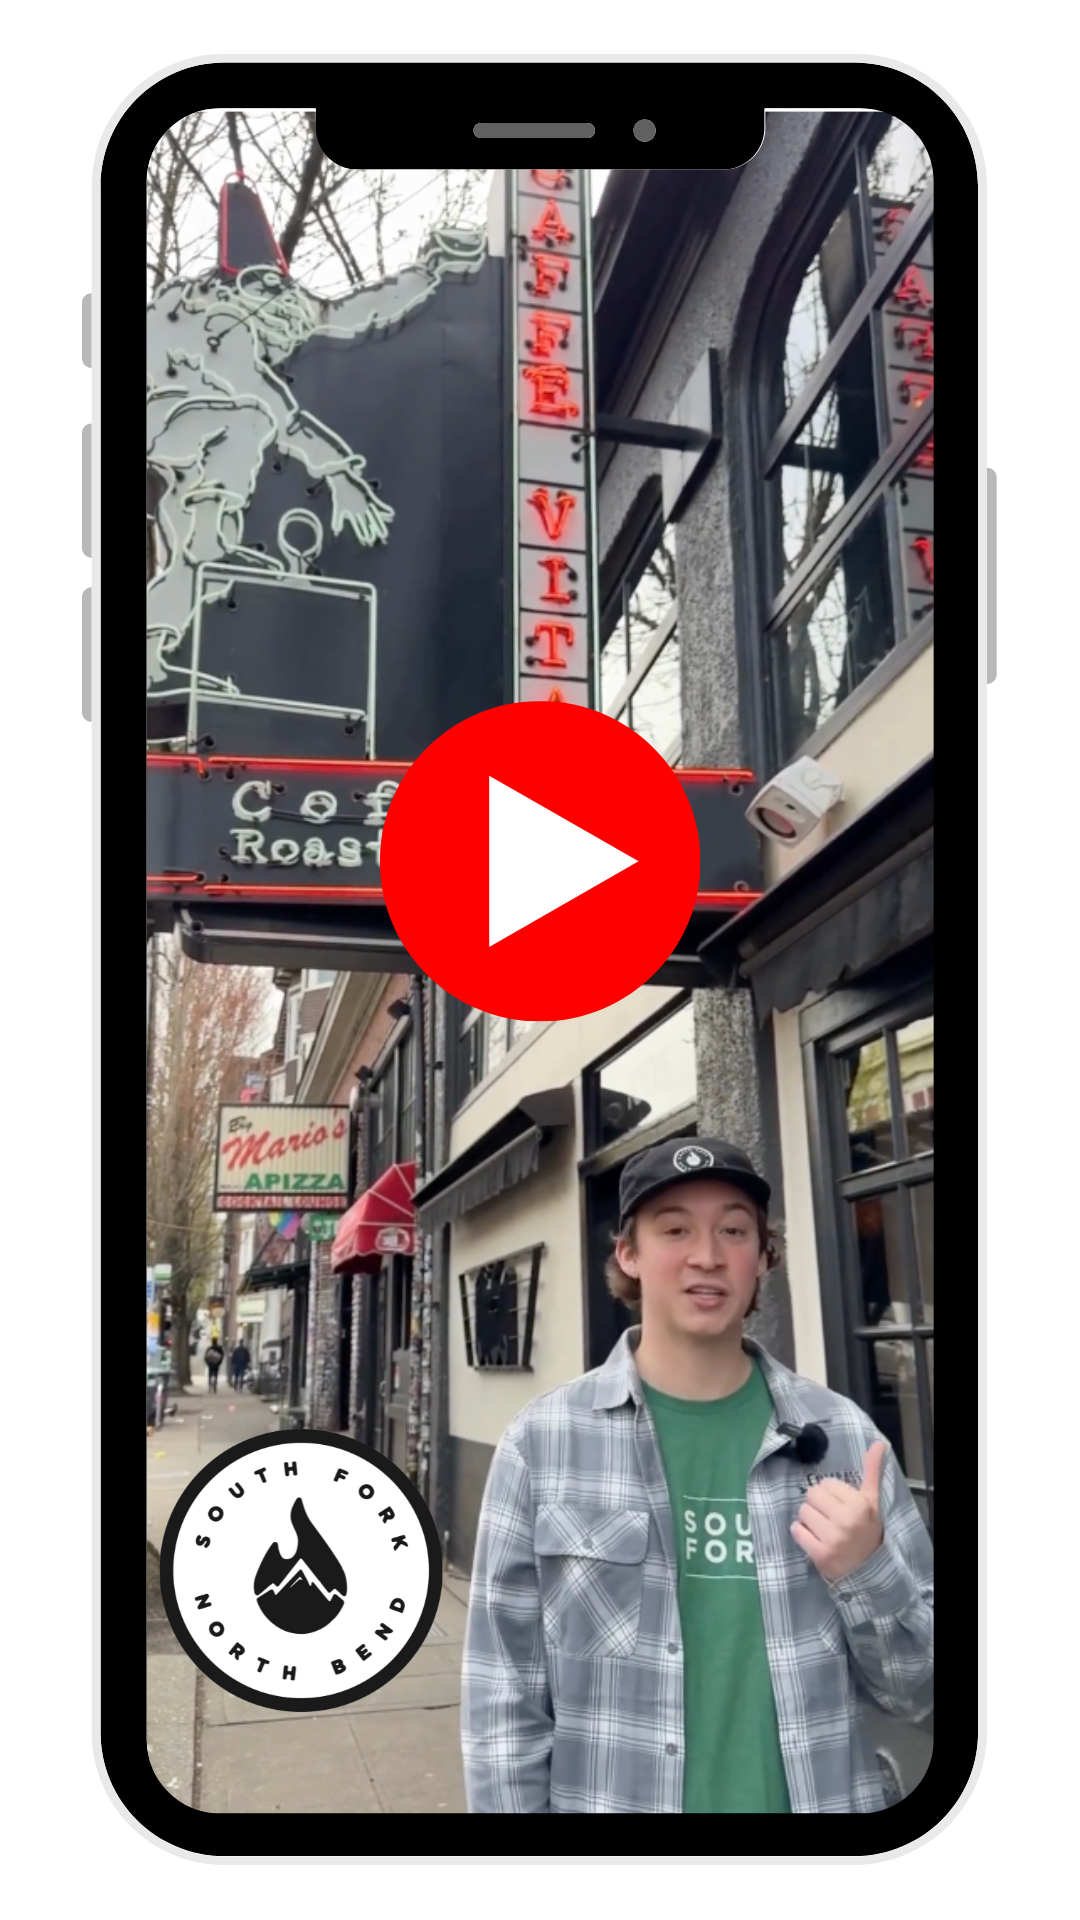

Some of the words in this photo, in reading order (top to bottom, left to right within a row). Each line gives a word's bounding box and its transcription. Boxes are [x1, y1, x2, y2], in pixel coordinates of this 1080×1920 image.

[221, 1107, 347, 1170] Mario's
[244, 1172, 345, 1191] APIZZA
[685, 1537, 754, 1563] FOR
